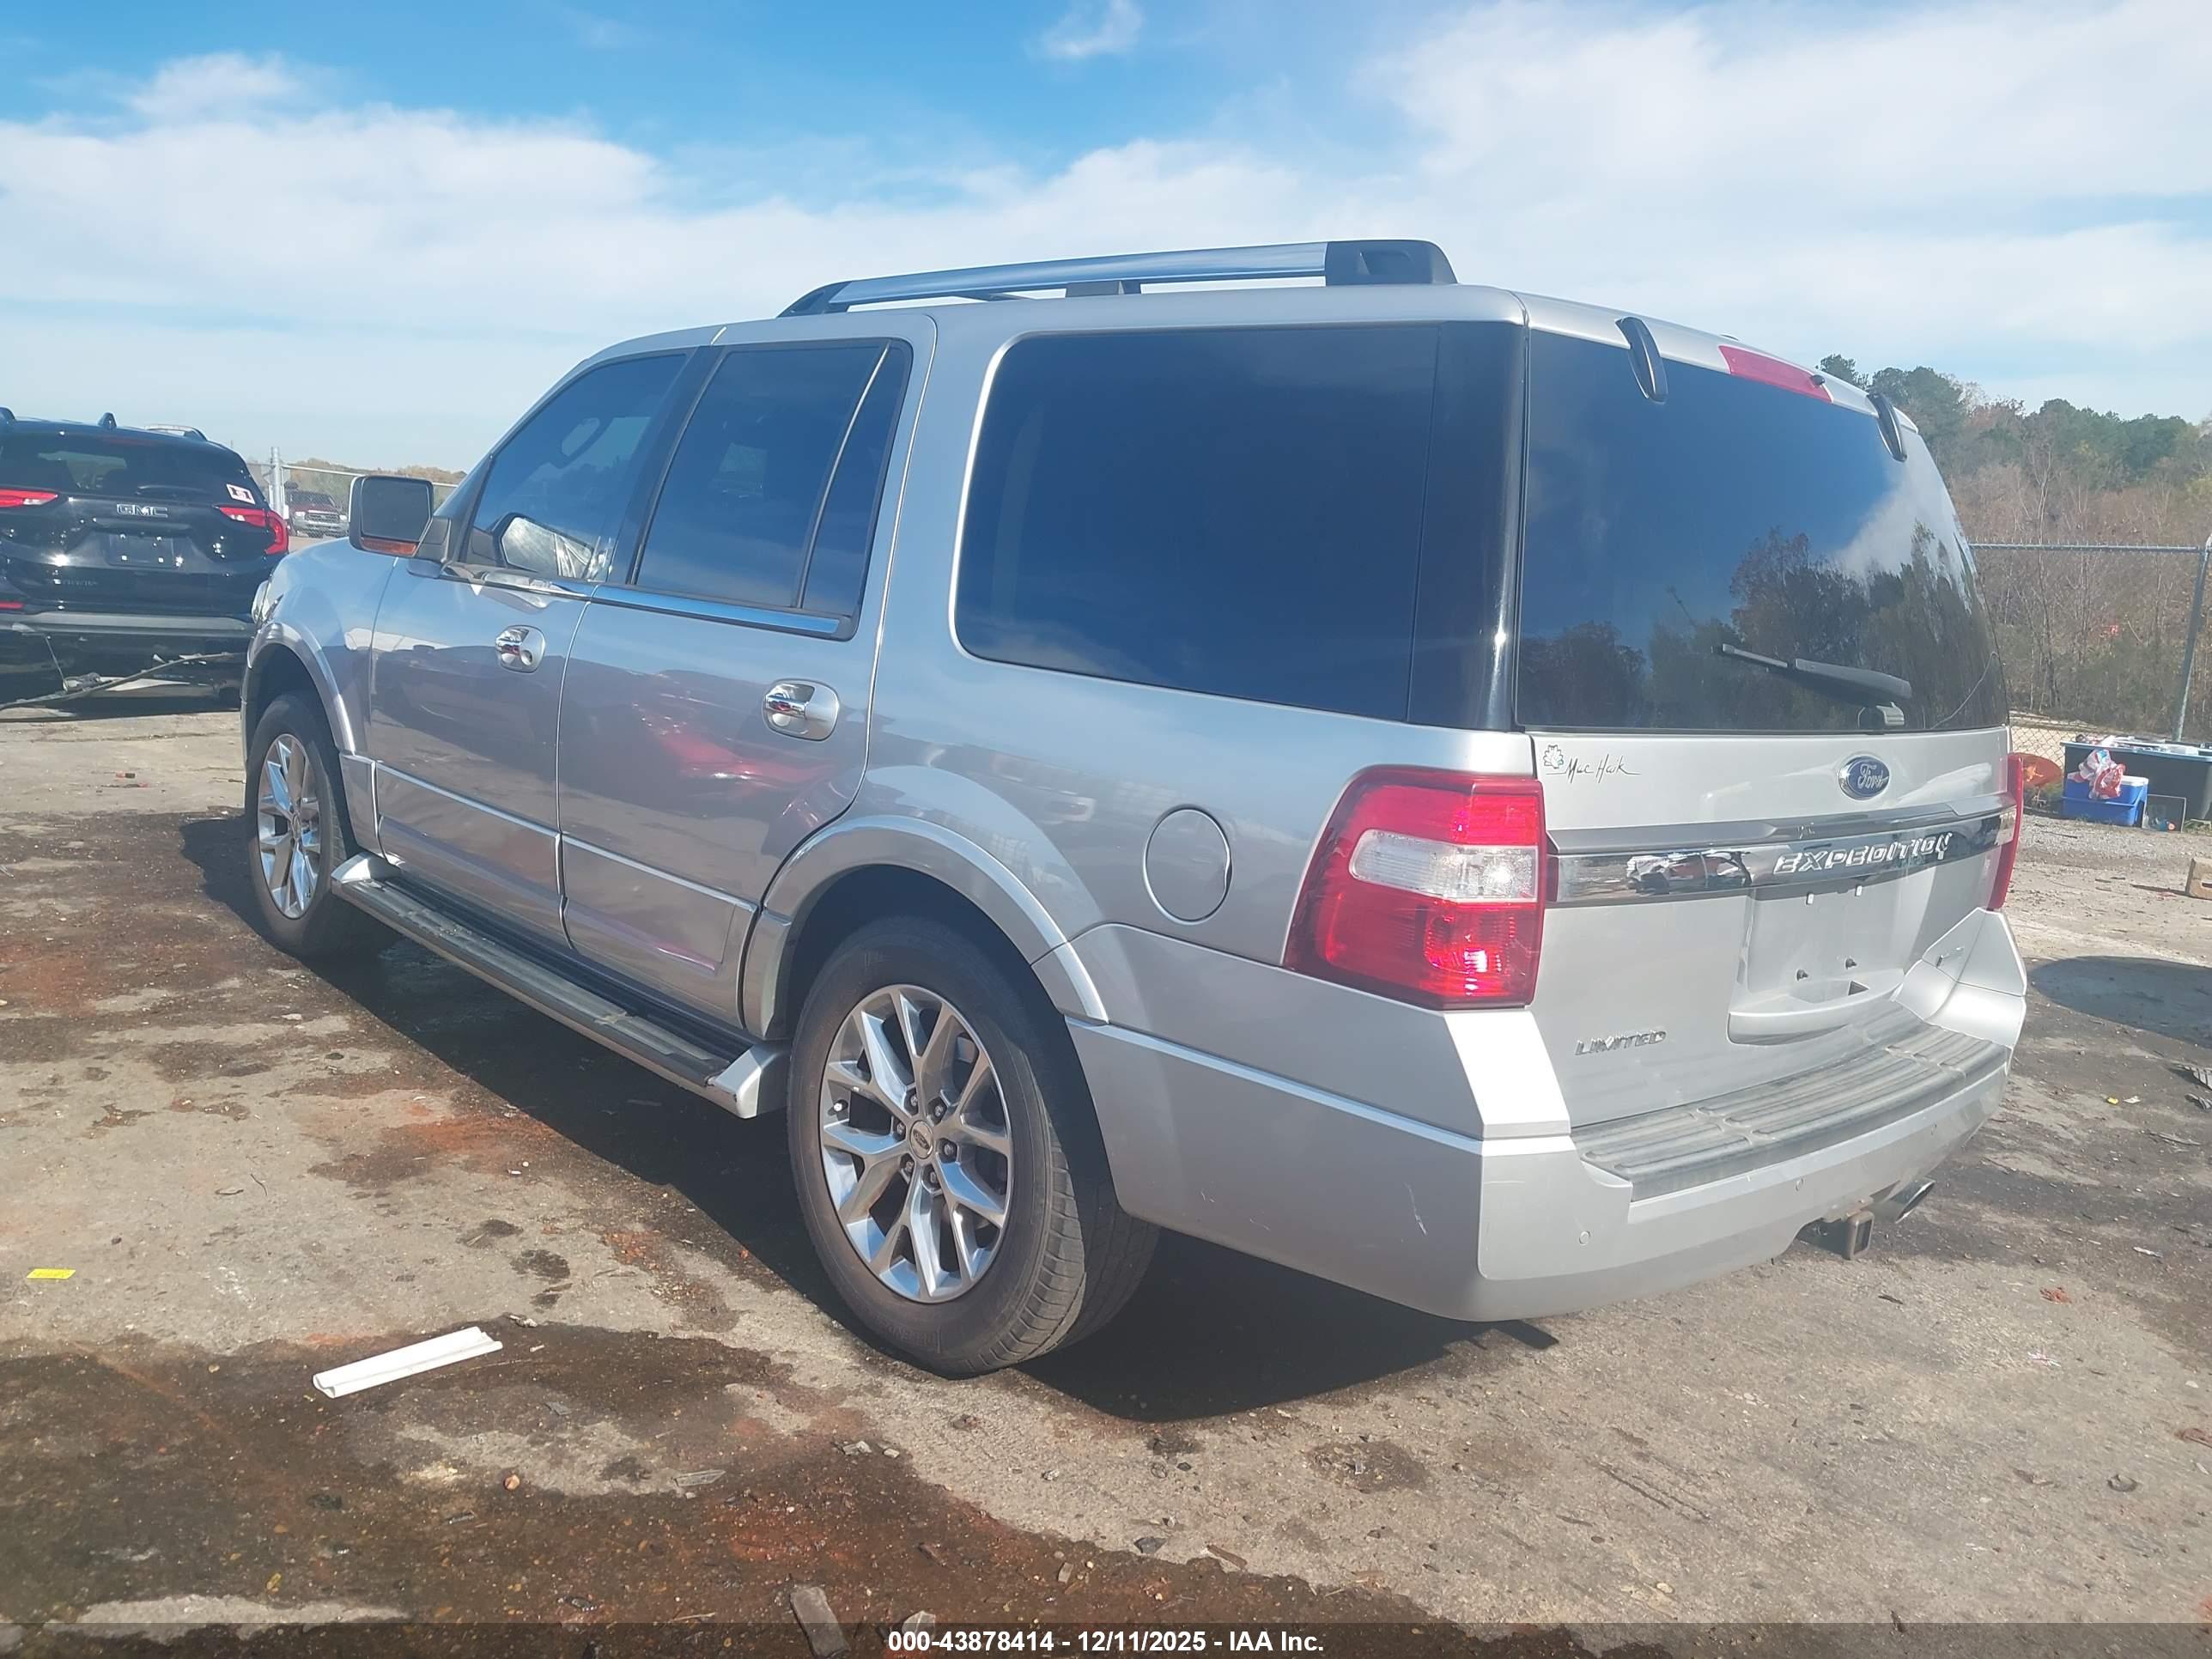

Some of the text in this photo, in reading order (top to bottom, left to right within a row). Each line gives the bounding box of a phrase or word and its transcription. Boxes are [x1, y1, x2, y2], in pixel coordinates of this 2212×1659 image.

[116, 503, 168, 519] GMC
[1564, 757, 1595, 783] Mac
[1856, 763, 1889, 789] Ford
[1772, 832, 1954, 875] EXPEDITION
[1575, 1030, 1667, 1055] LIMITED
